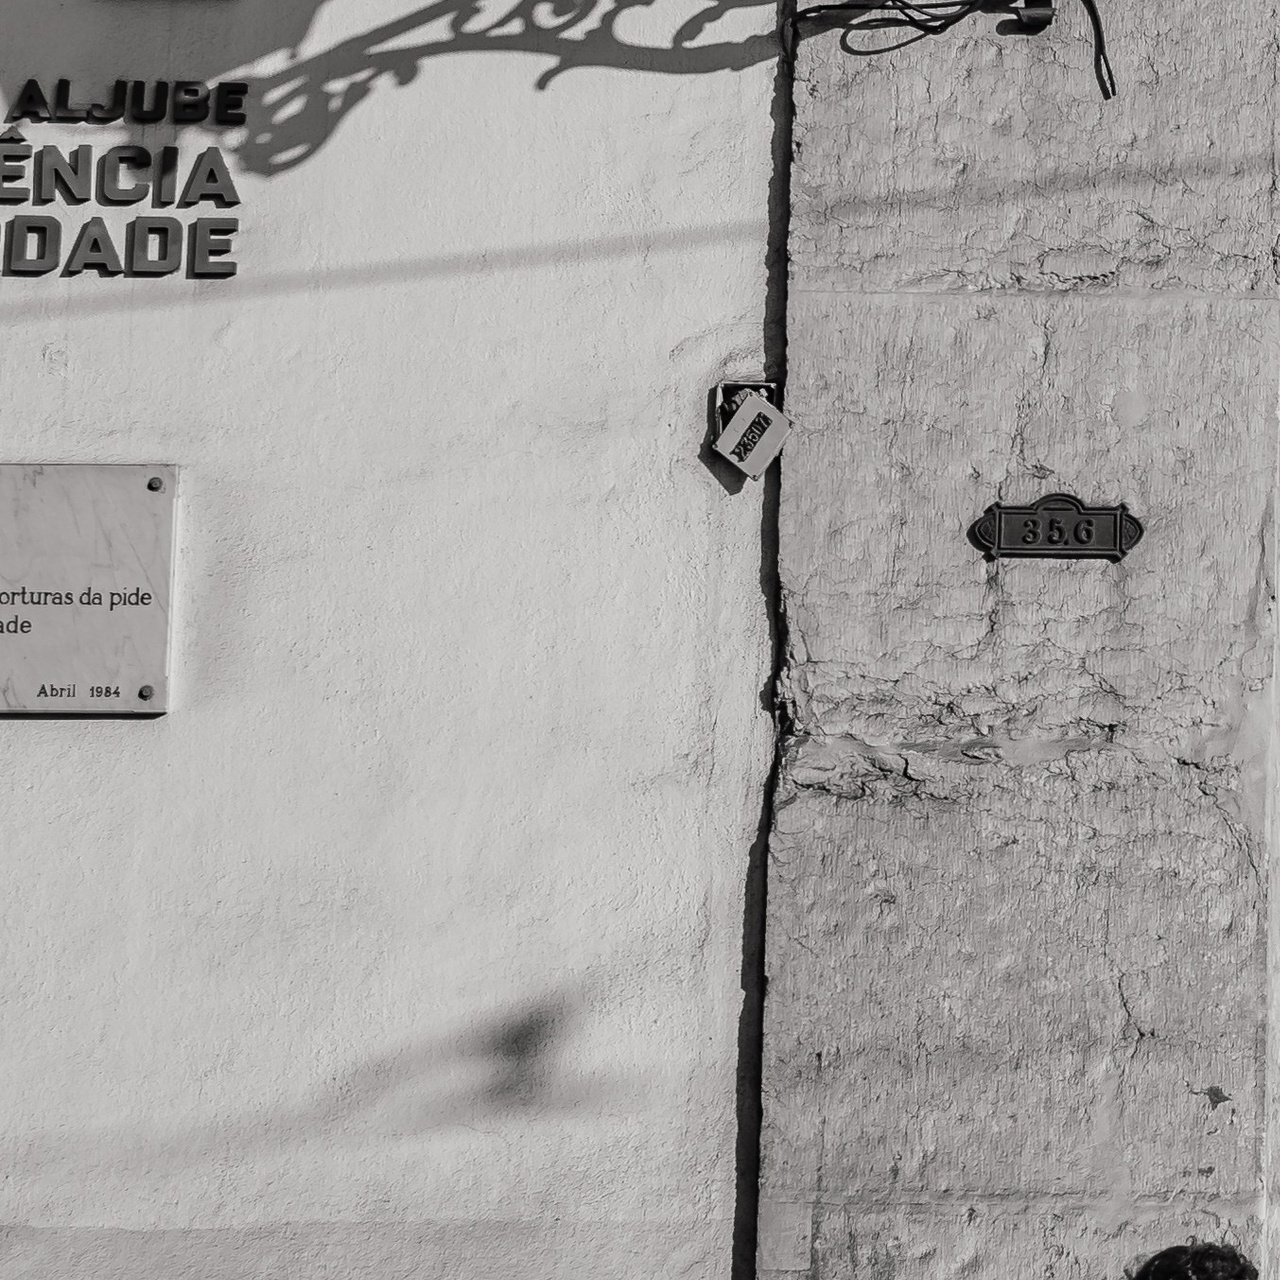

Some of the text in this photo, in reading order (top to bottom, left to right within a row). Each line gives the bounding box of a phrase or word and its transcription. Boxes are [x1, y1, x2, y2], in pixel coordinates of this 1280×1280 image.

[6, 79, 249, 125] ALJUBE
[0, 125, 241, 209] ÊNCIA
[2, 215, 239, 279] DADE
[0, 586, 152, 611] orturas da pide
[37, 684, 121, 698] Abril 1984
